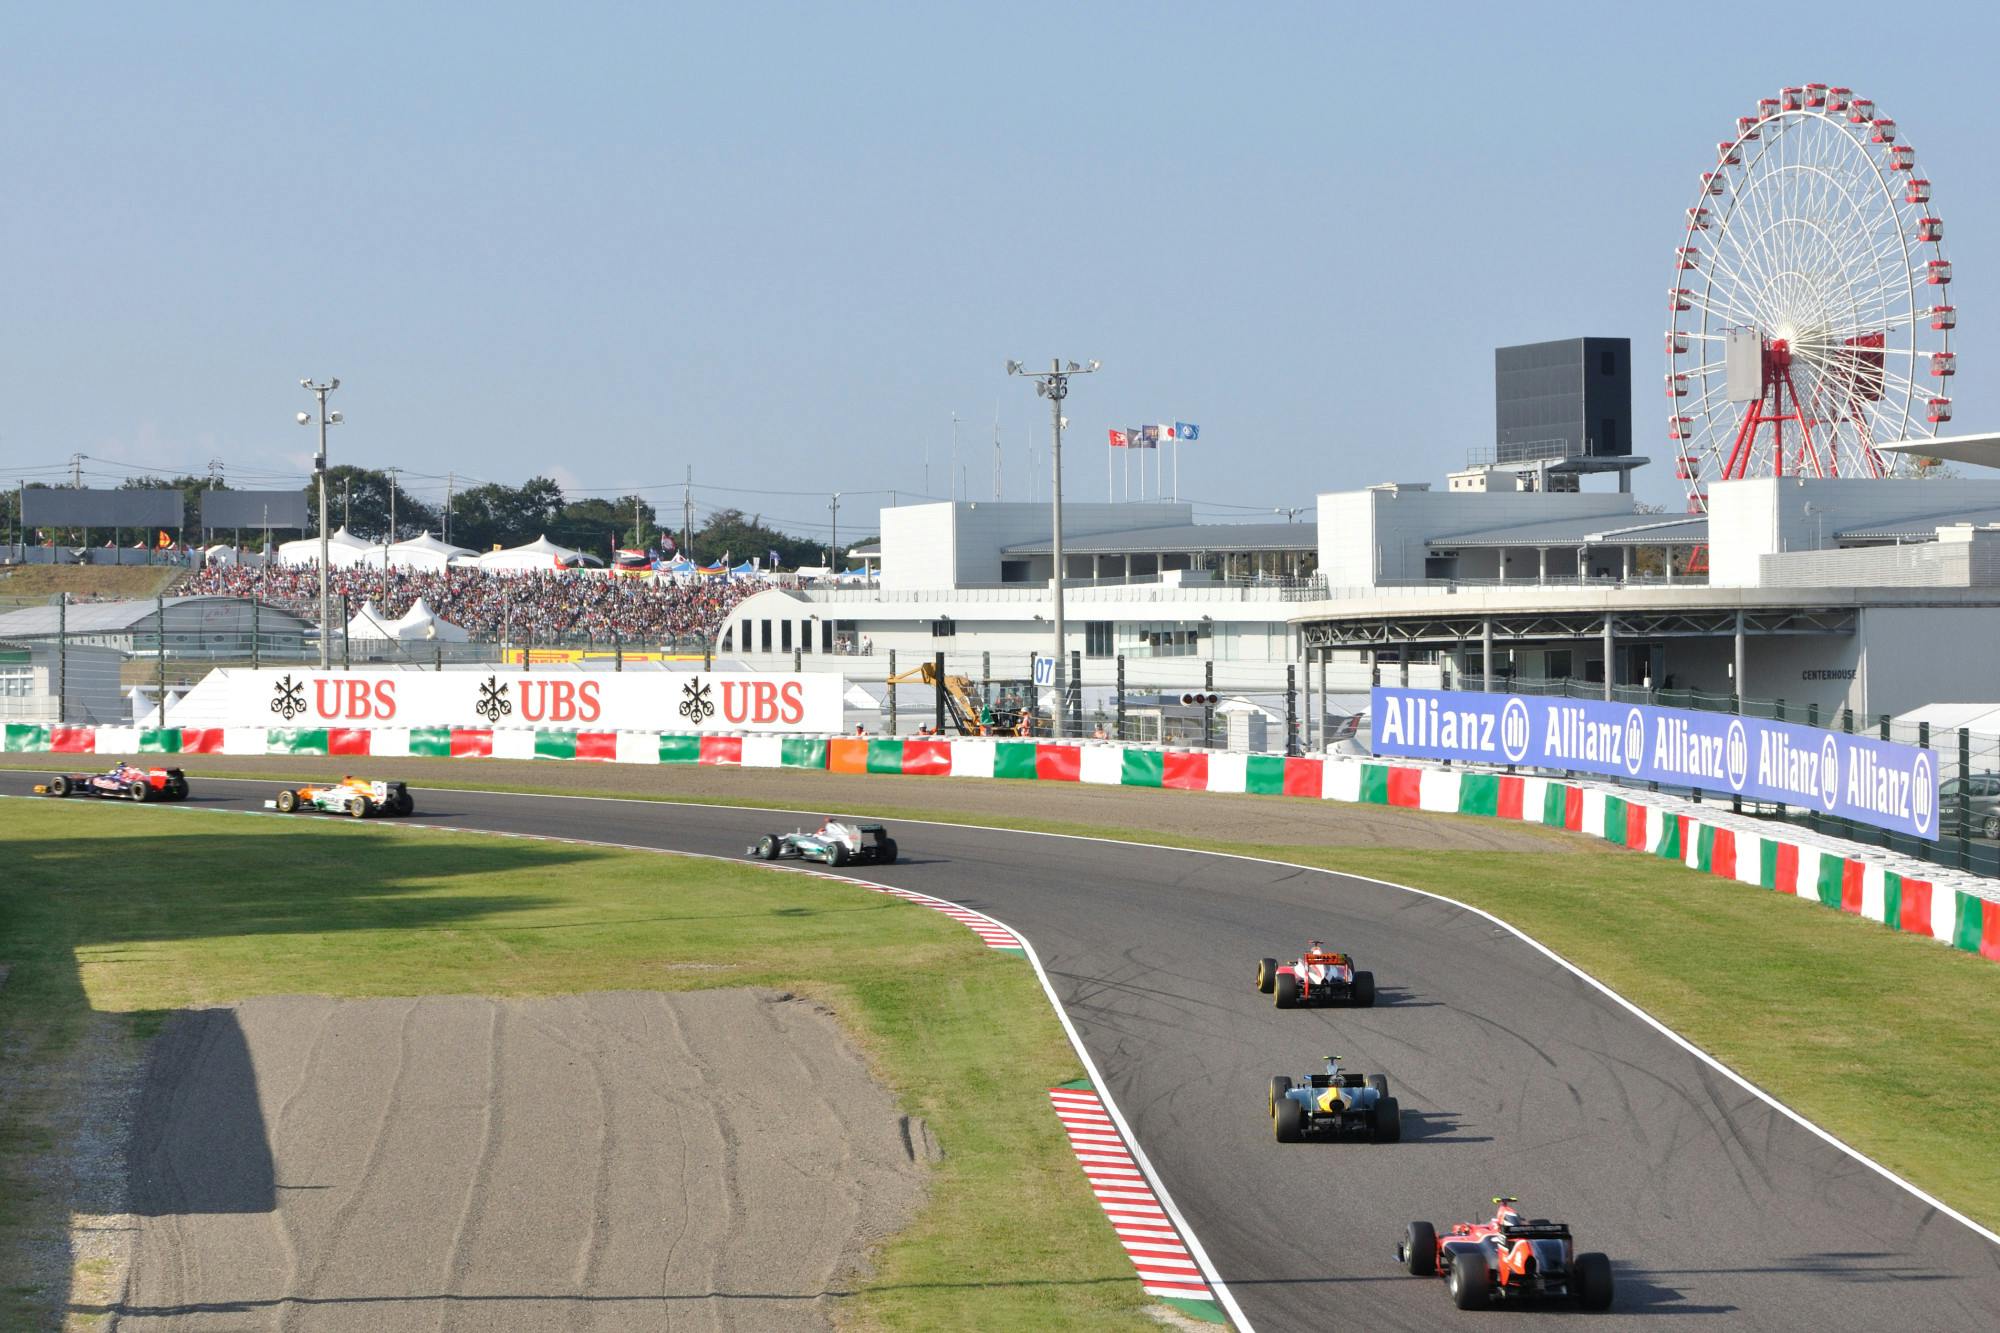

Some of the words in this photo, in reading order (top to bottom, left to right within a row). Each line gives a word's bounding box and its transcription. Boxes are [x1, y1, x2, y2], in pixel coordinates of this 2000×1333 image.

[1035, 658, 1053, 684] 07
[1802, 670, 1857, 680] CENTERHOUSE
[315, 679, 396, 720] UBS
[520, 680, 601, 722] UBS
[721, 681, 804, 724] UBS
[1381, 696, 1495, 752] Allianz
[1544, 706, 1622, 764] Allianz
[1653, 716, 1724, 779] Allianz
[1757, 729, 1819, 797] Allianz
[1846, 745, 1911, 819] Allianz
